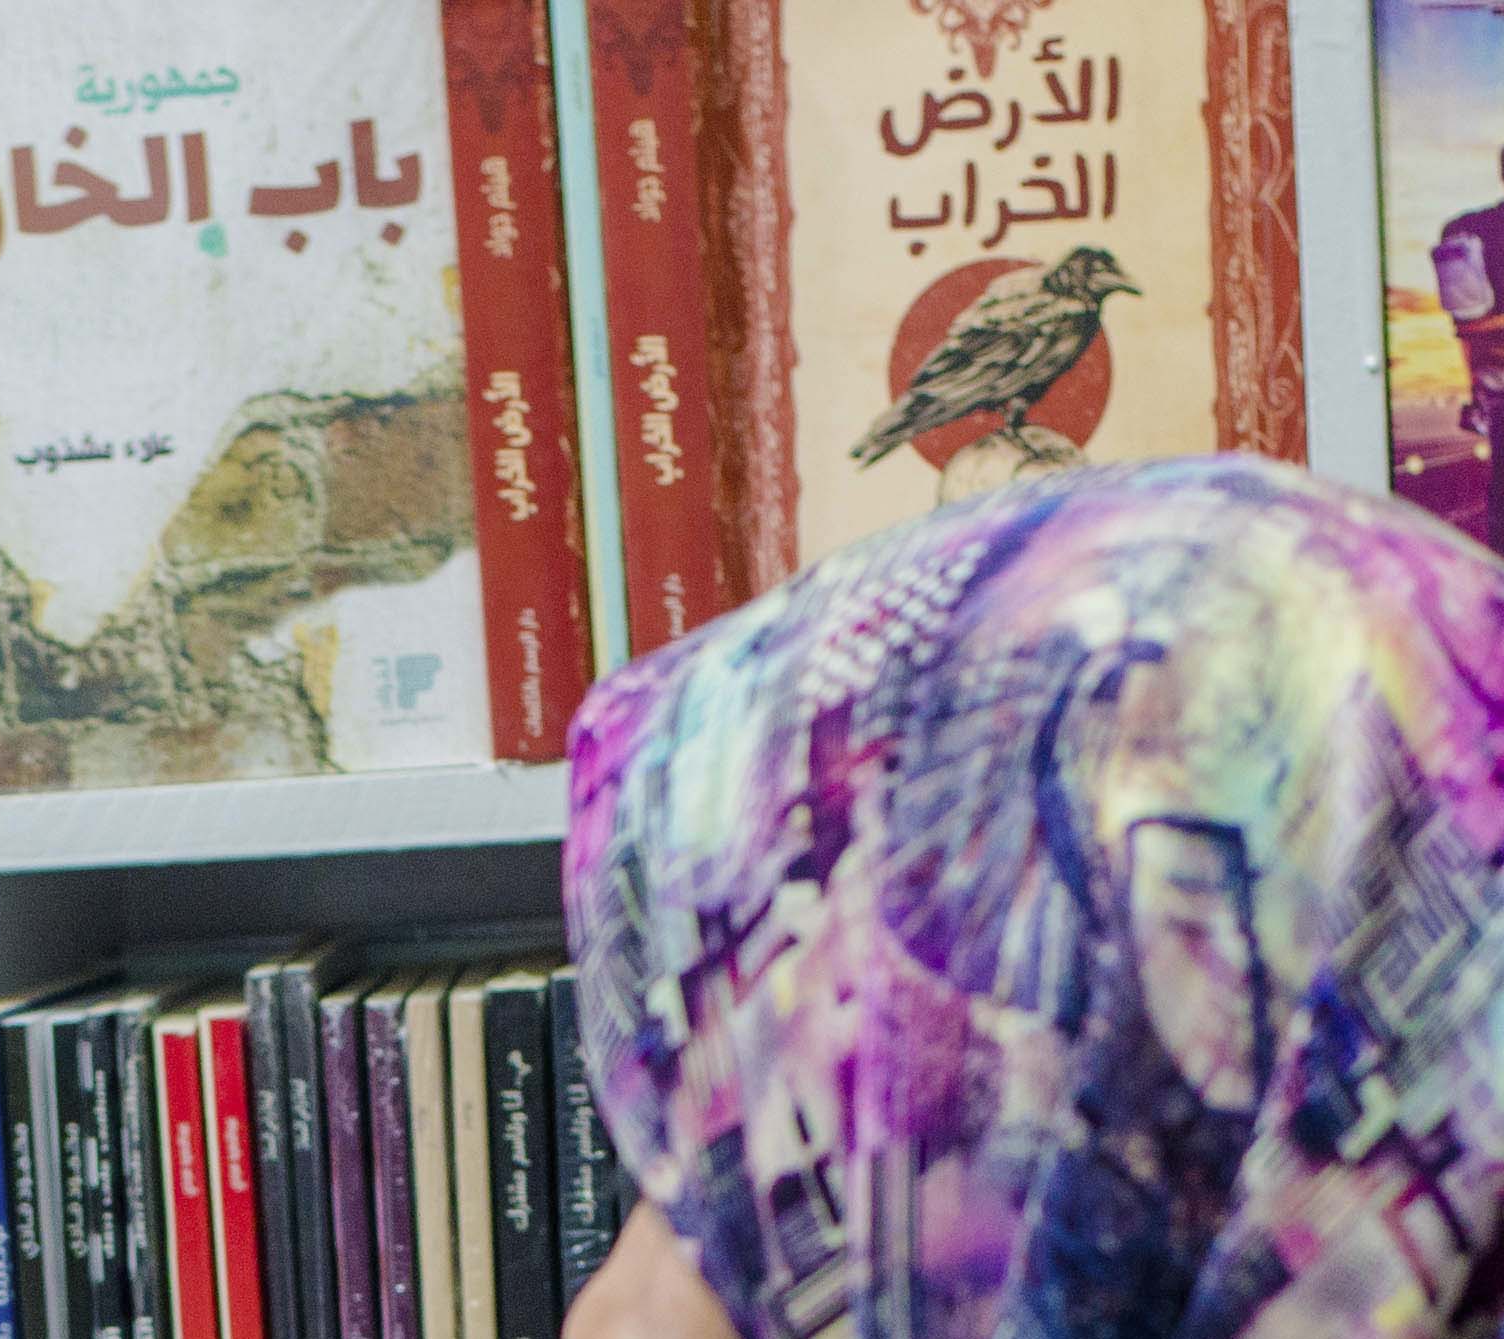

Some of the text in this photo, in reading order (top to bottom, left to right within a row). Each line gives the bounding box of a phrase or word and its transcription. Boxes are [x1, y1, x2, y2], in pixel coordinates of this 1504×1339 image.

[75, 64, 240, 116] جمهورية
[878, 34, 1122, 156] الأرض
[248, 118, 423, 254] باب
[888, 153, 1117, 256] الخراب
[123, 433, 176, 464] علاء
